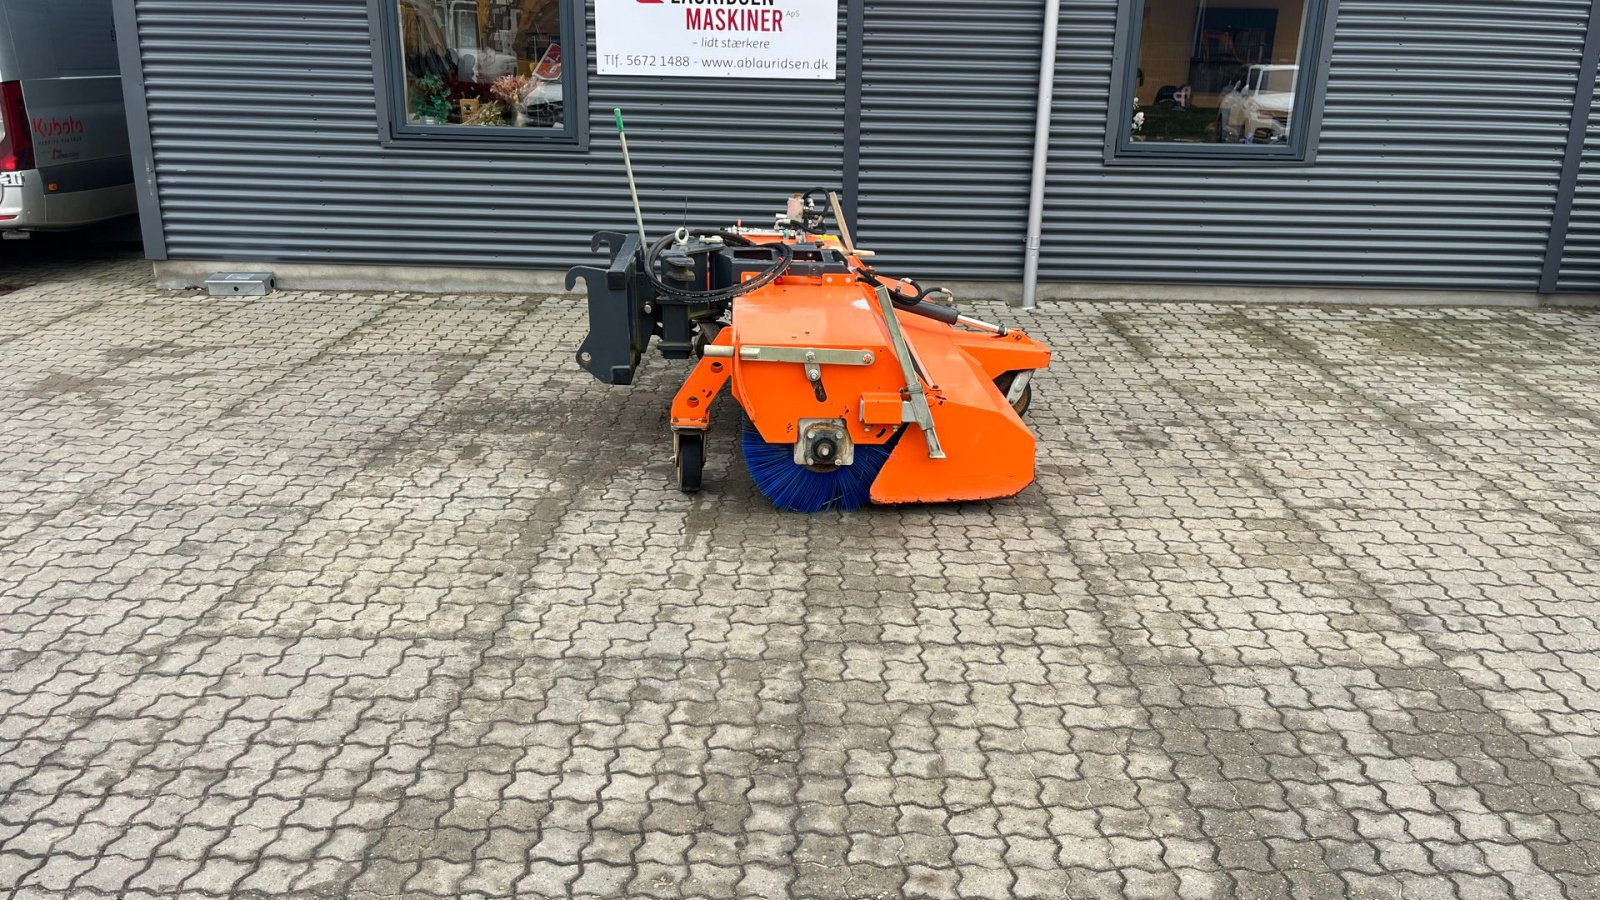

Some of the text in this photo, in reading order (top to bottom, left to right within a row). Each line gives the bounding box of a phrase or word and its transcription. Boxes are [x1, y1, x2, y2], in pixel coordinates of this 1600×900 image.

[686, 8, 783, 32] MASKINER
[785, 9, 800, 18] ApS
[701, 37, 719, 48] lidt
[721, 38, 770, 49] stærkere
[603, 54, 623, 68] Tlf.
[626, 54, 657, 67] 5672
[660, 55, 690, 67] 1488
[701, 57, 829, 70] www.ablauridsen.dk
[32, 115, 84, 138] Kubota
